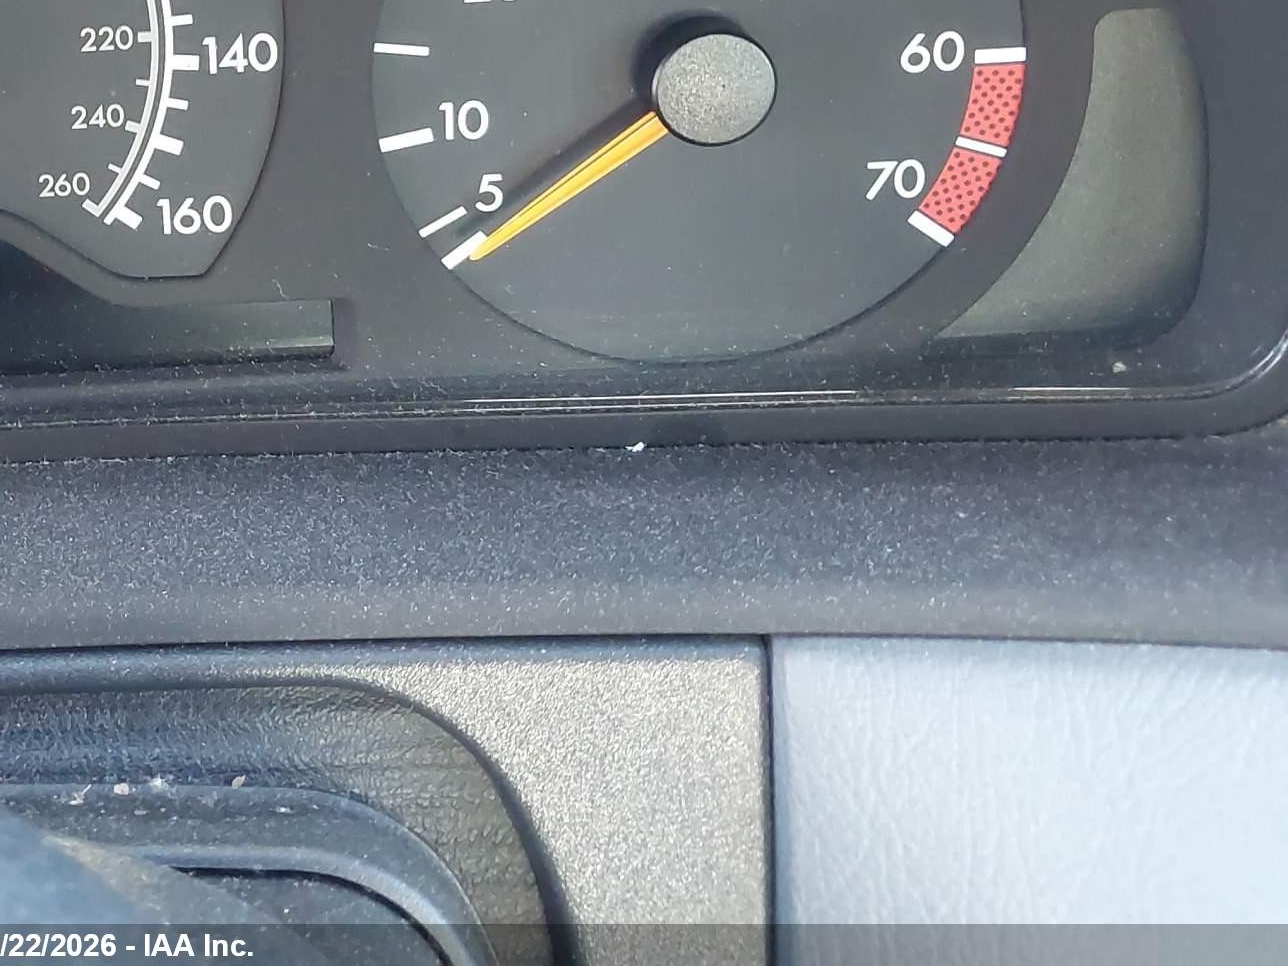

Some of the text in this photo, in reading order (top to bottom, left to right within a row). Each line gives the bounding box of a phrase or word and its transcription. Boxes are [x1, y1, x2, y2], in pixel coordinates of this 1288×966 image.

[80, 26, 134, 52] 220
[201, 33, 278, 75] 140
[899, 31, 964, 73] 60
[71, 104, 124, 130] 240
[438, 101, 489, 140] 10
[39, 172, 90, 197] 260
[475, 174, 504, 214] 5
[865, 160, 925, 201] 70
[157, 194, 233, 235] 160
